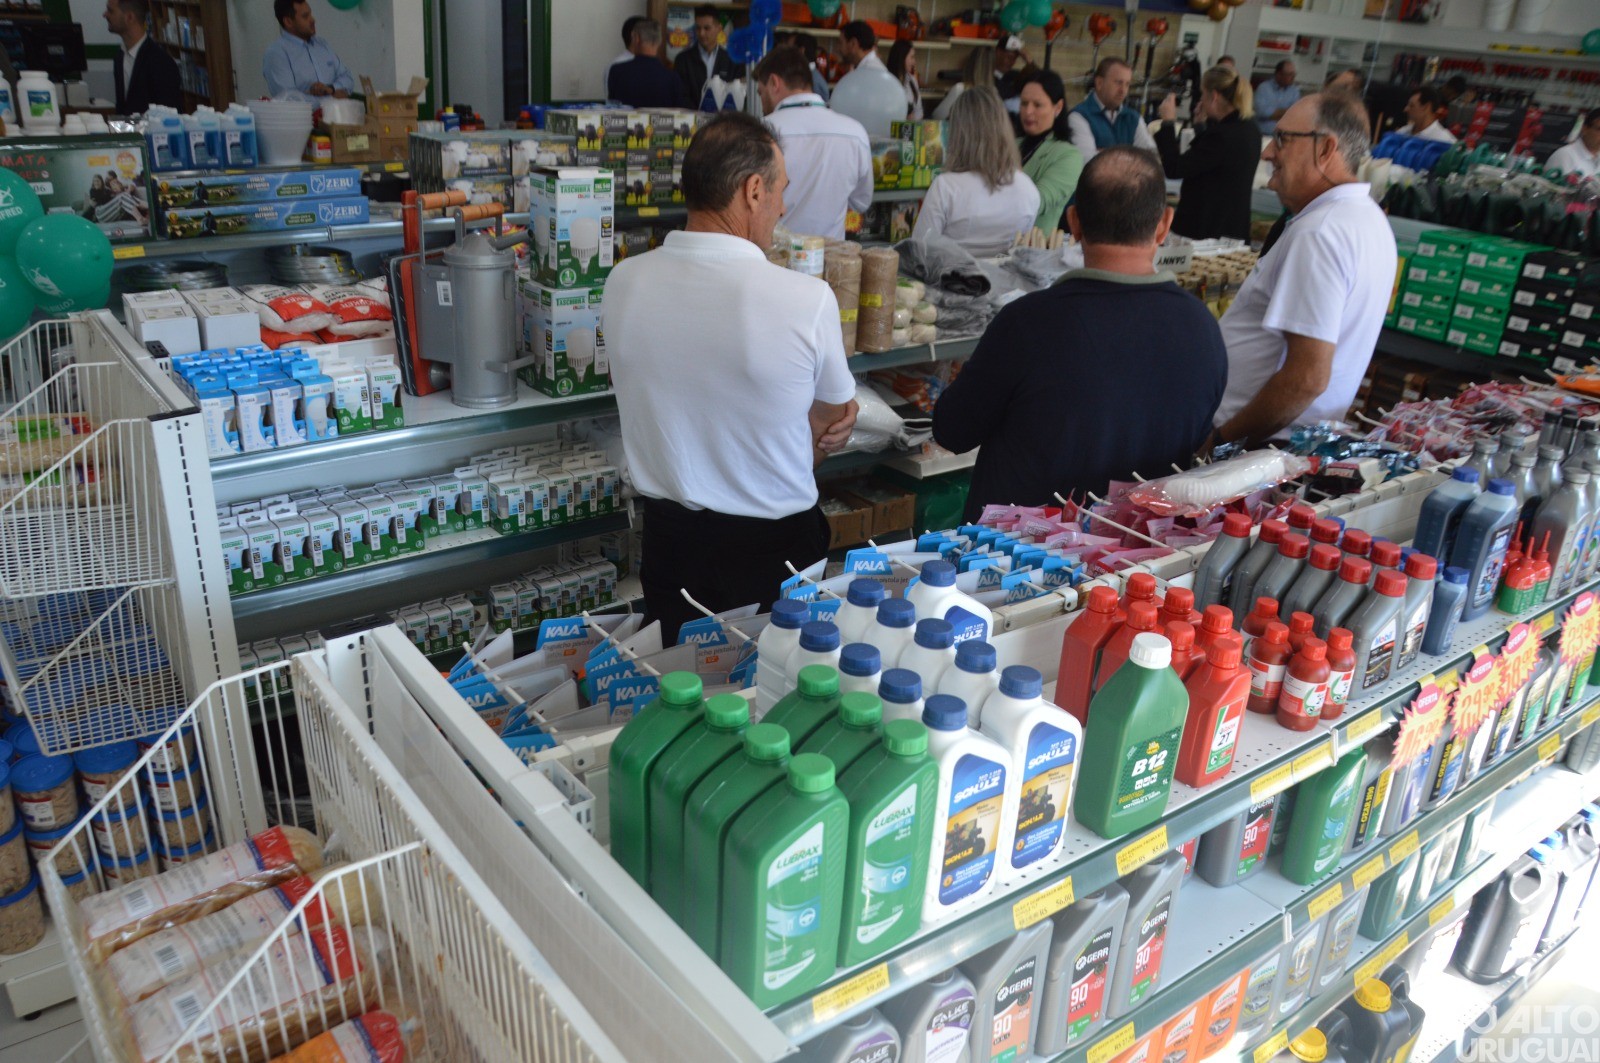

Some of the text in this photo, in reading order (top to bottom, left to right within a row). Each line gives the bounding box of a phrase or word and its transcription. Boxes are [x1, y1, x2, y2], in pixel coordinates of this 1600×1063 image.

[326, 176, 354, 189] ZEBU
[334, 204, 362, 217] ZEBU
[854, 560, 886, 572] KALA
[1044, 573, 1069, 585] KALA
[1006, 587, 1036, 603] KALA
[546, 624, 580, 639] KALA
[1374, 631, 1393, 645] Mobil
[1471, 661, 1492, 678] OFERTA
[616, 684, 656, 701] KALA
[1417, 692, 1438, 709] OFERTA
[1217, 731, 1232, 747] 2T
[1028, 745, 1071, 770] SCHULZ
[1131, 750, 1168, 777] B12
[954, 776, 1000, 804] SCHULZ
[873, 804, 914, 829] LUBRAX
[1018, 812, 1044, 830] SCHULZ
[1243, 825, 1258, 846] 90
[1152, 841, 1167, 854] 85,00
[776, 844, 820, 869] LUBRAX
[945, 848, 974, 867] SCHULZ
[1056, 894, 1073, 906] 56,00
[1150, 910, 1168, 926] GEAR
[1086, 946, 1109, 965] GEAR
[1135, 946, 1151, 971] 90
[1009, 976, 1033, 993] GEAR
[1070, 982, 1089, 1008] 90
[931, 1000, 970, 1029] FALKE
[993, 1013, 1012, 1040] 90
